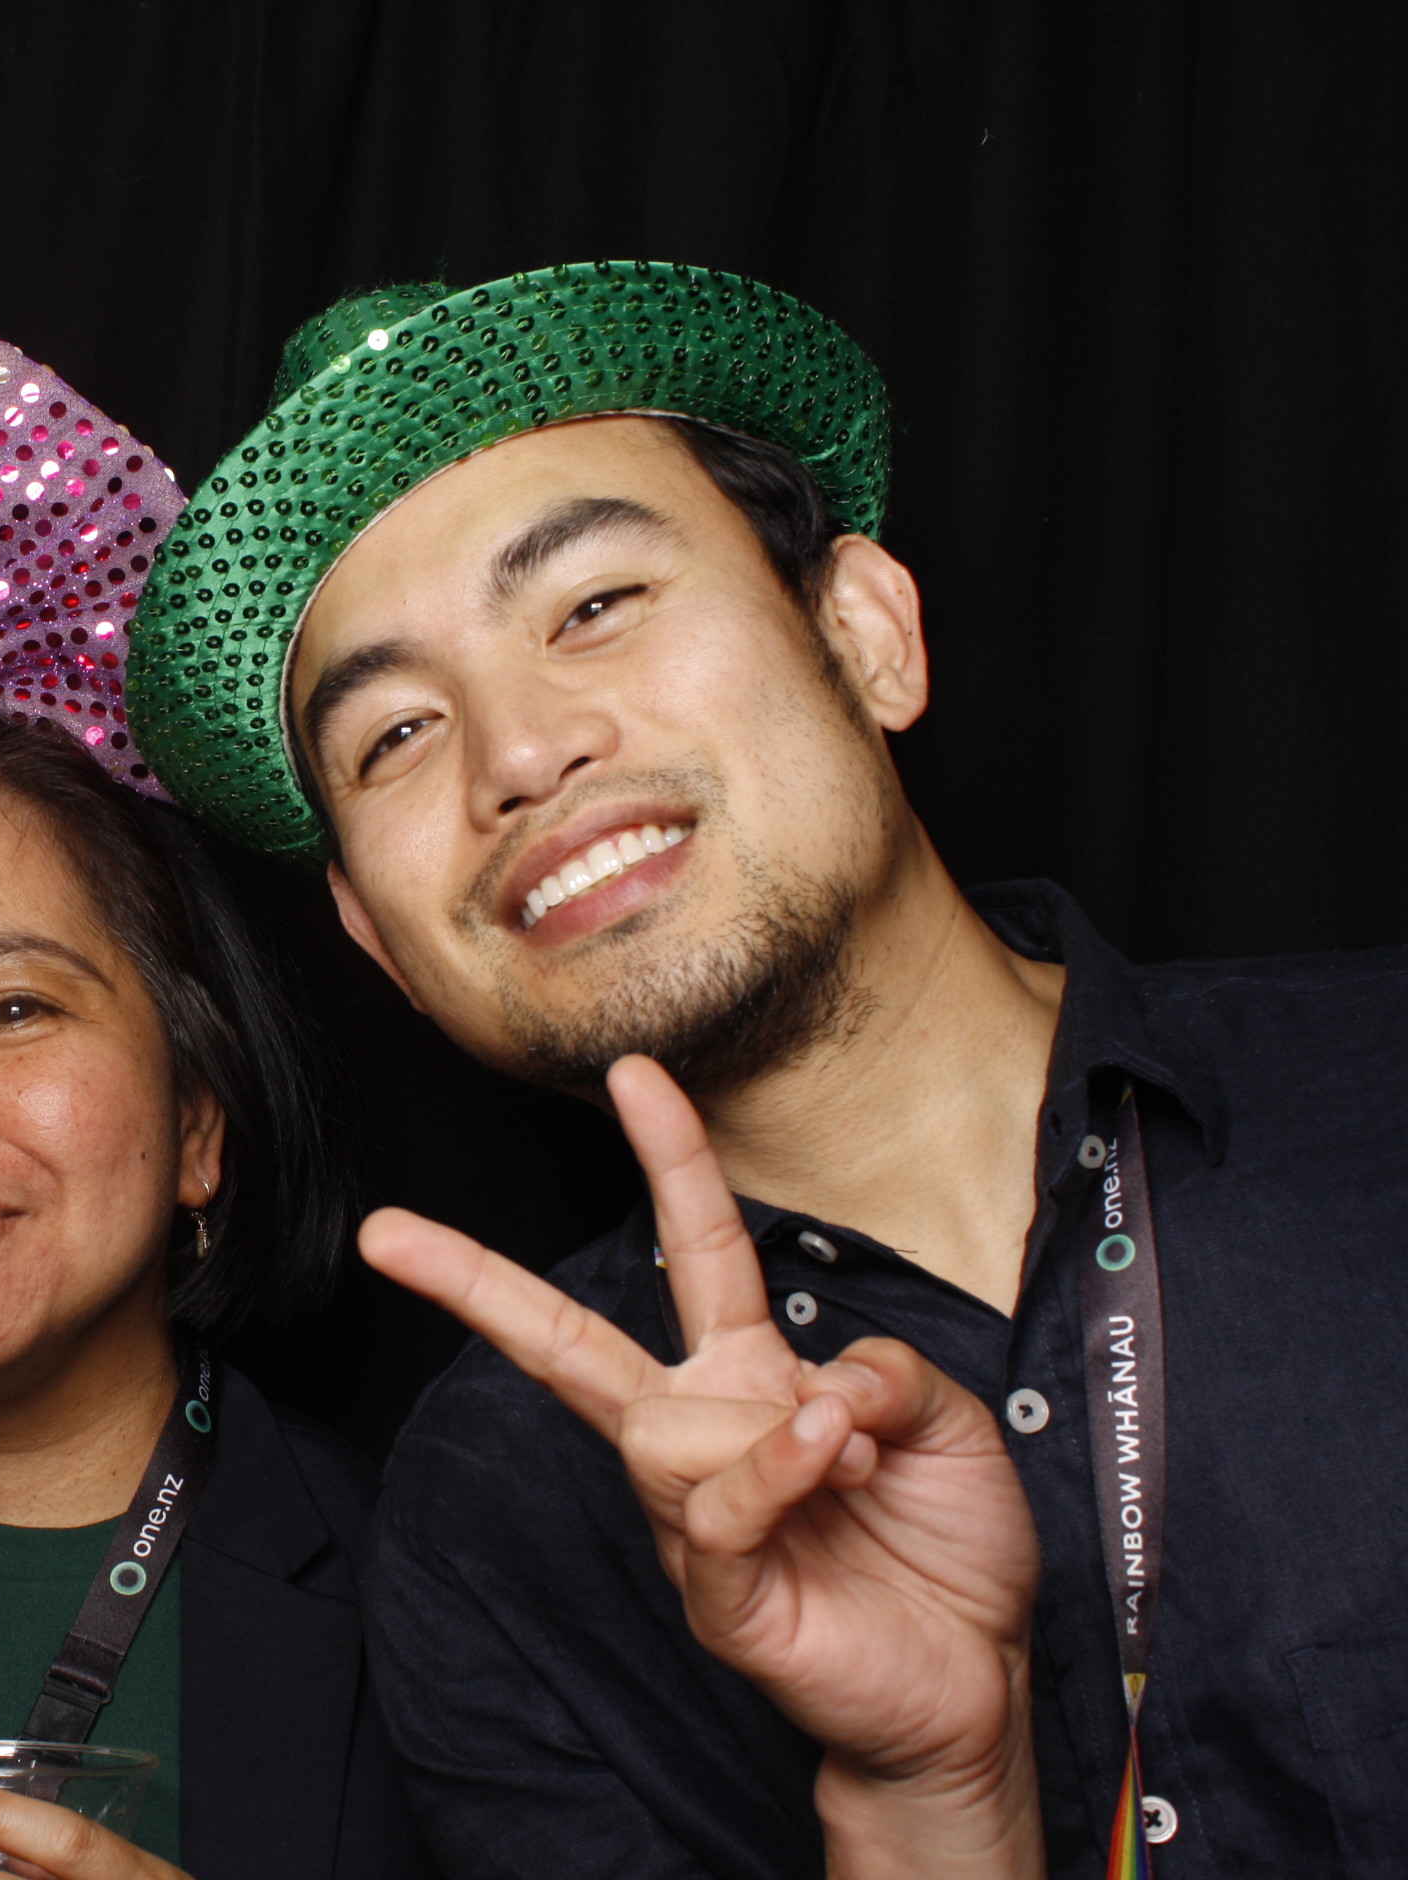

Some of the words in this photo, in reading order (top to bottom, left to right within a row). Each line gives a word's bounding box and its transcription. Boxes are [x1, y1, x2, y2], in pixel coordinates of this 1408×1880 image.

[1107, 1315, 1141, 1464] WHĀNAU
[133, 1473, 184, 1557] one.nz
[1117, 1472, 1145, 1635] RAINBOW
